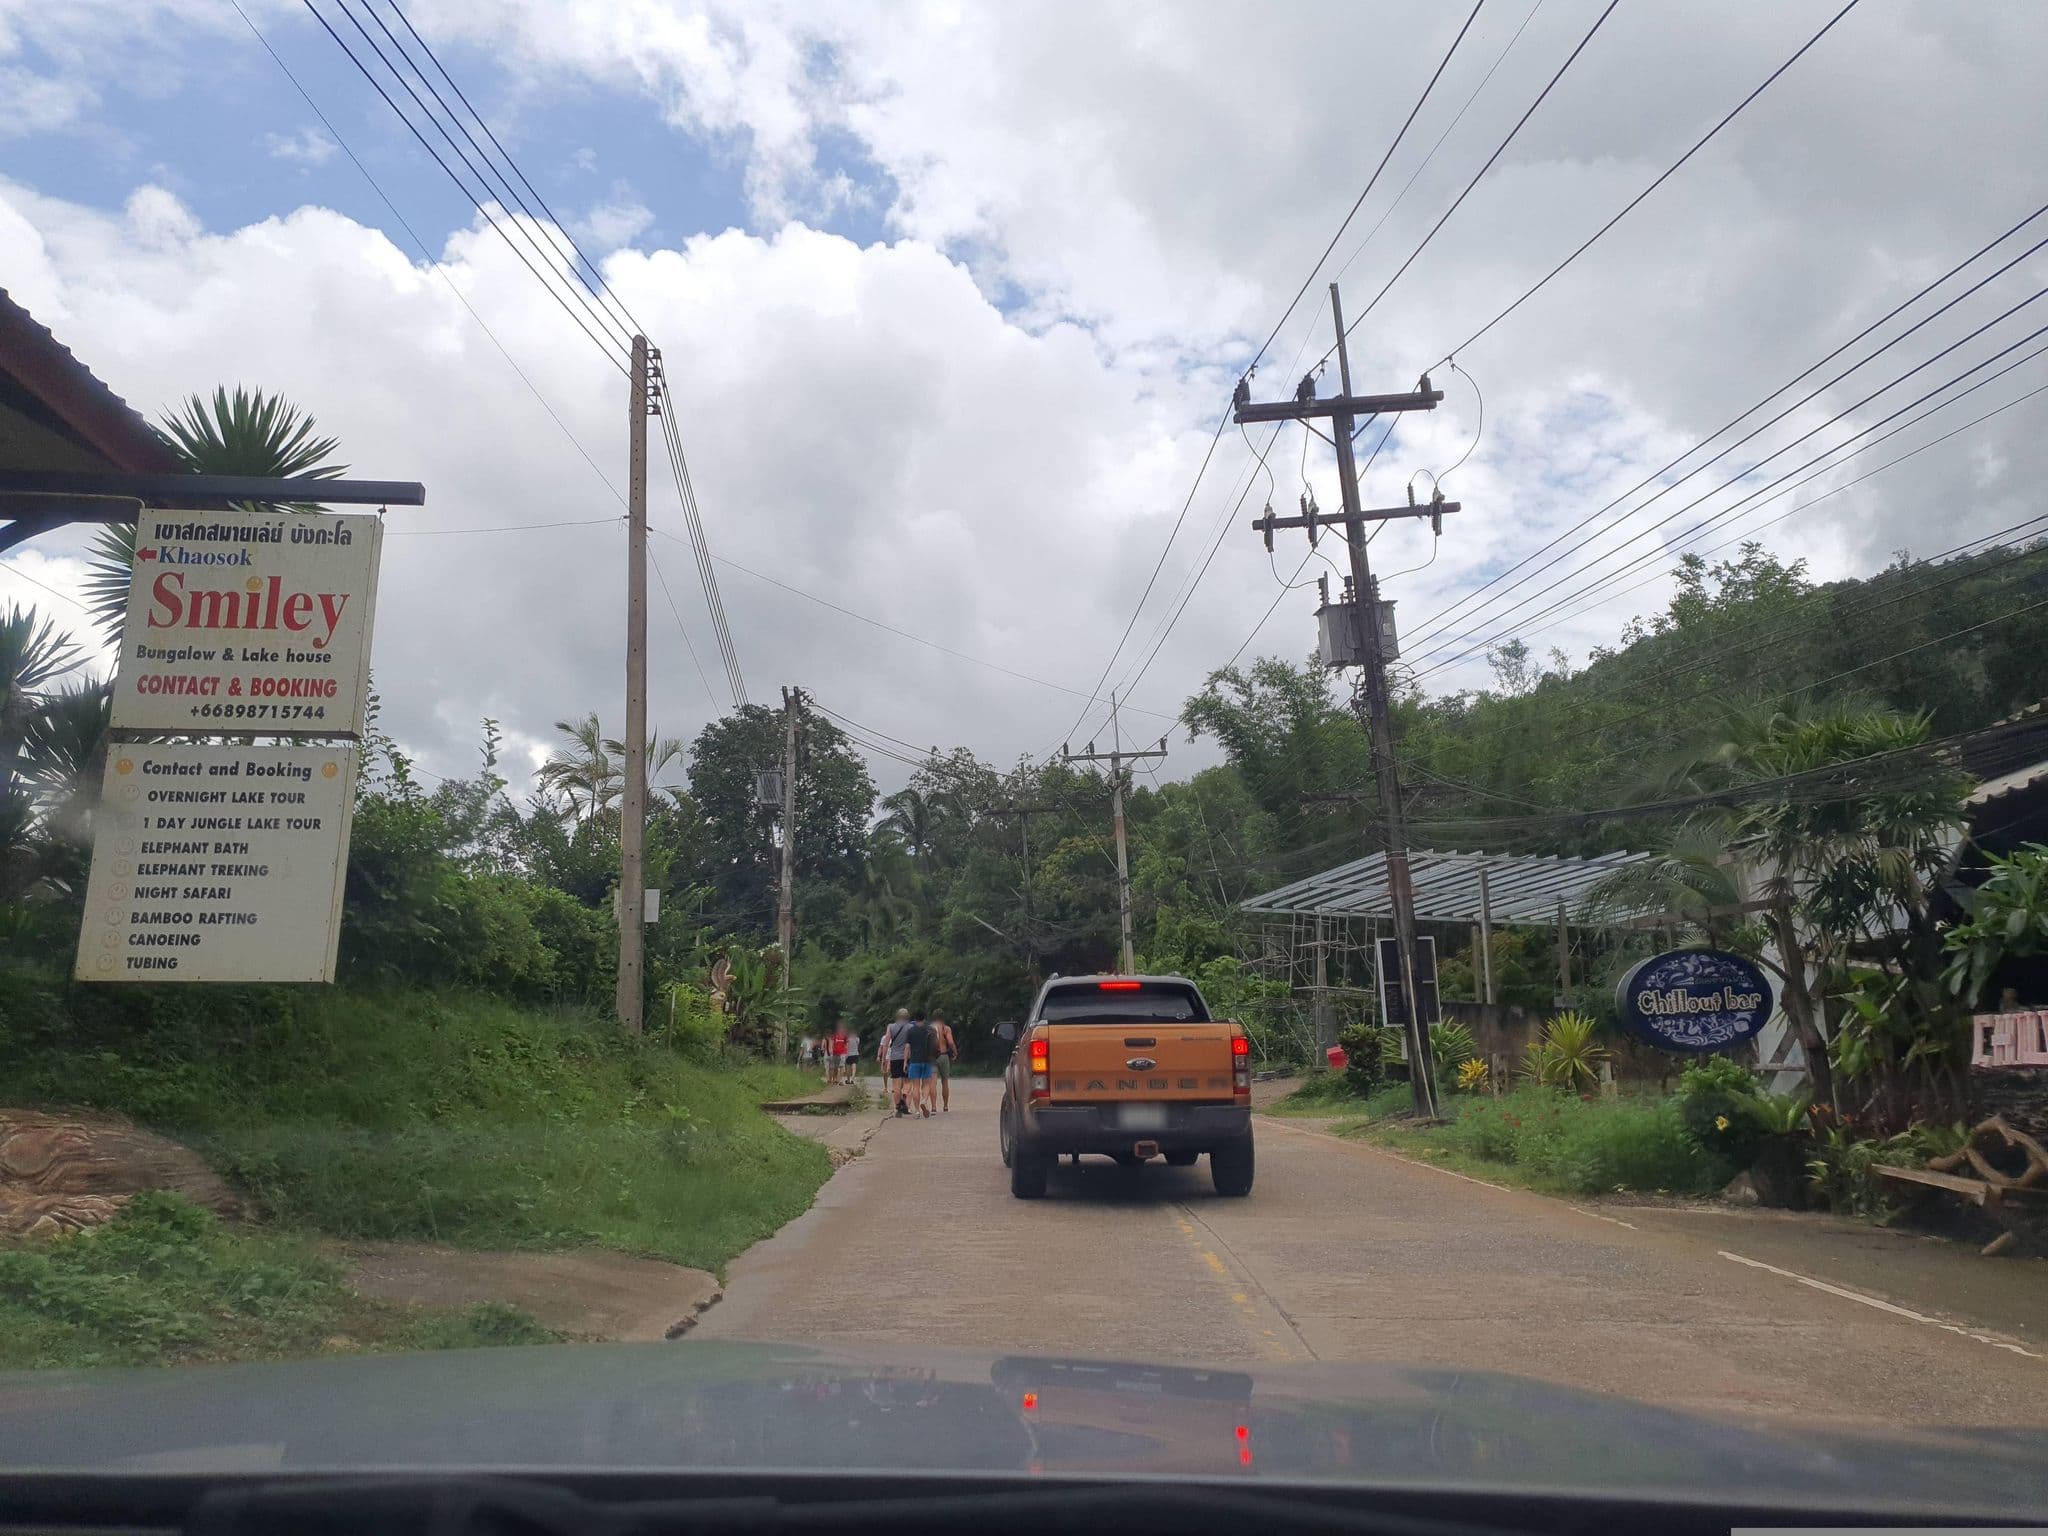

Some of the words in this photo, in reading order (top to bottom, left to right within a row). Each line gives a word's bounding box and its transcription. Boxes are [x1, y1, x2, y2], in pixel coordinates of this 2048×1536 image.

[290, 519, 353, 546] บังกะโล
[159, 545, 253, 566] Khaosok
[147, 571, 350, 649] Smiley
[136, 644, 216, 664] Bungalow
[222, 648, 234, 661] &
[241, 648, 279, 663] Lake
[286, 649, 332, 663] house
[136, 675, 220, 696] CONTACT
[228, 677, 242, 696] &
[250, 677, 338, 698] BOOKING
[190, 704, 325, 720] +66898715744
[142, 760, 202, 777] Contact
[208, 761, 240, 777] and
[246, 762, 312, 781] Booking
[147, 790, 227, 803] OVERNIGHT
[232, 791, 265, 804] LAKE
[270, 792, 306, 805] TOUR
[143, 817, 150, 829] 1
[157, 818, 185, 830] DAY
[191, 818, 242, 830] JUNGLE
[247, 818, 281, 830] LAKE
[286, 818, 322, 830] TOUR
[141, 842, 209, 854] ELEPHANT
[213, 842, 249, 855] BATH
[137, 864, 206, 876] ELEPHANT
[211, 864, 269, 877] TREKING
[134, 886, 178, 899] NIGHT
[183, 887, 232, 900] SAFARI
[130, 912, 193, 925] BAMBOO
[198, 912, 258, 925] RAFTING
[128, 934, 201, 946] CANOEING
[126, 957, 179, 969] TUBING
[1637, 988, 1722, 1015] Chillout
[1724, 986, 1762, 1010] bar
[1971, 1010, 2048, 1067] CHIL
